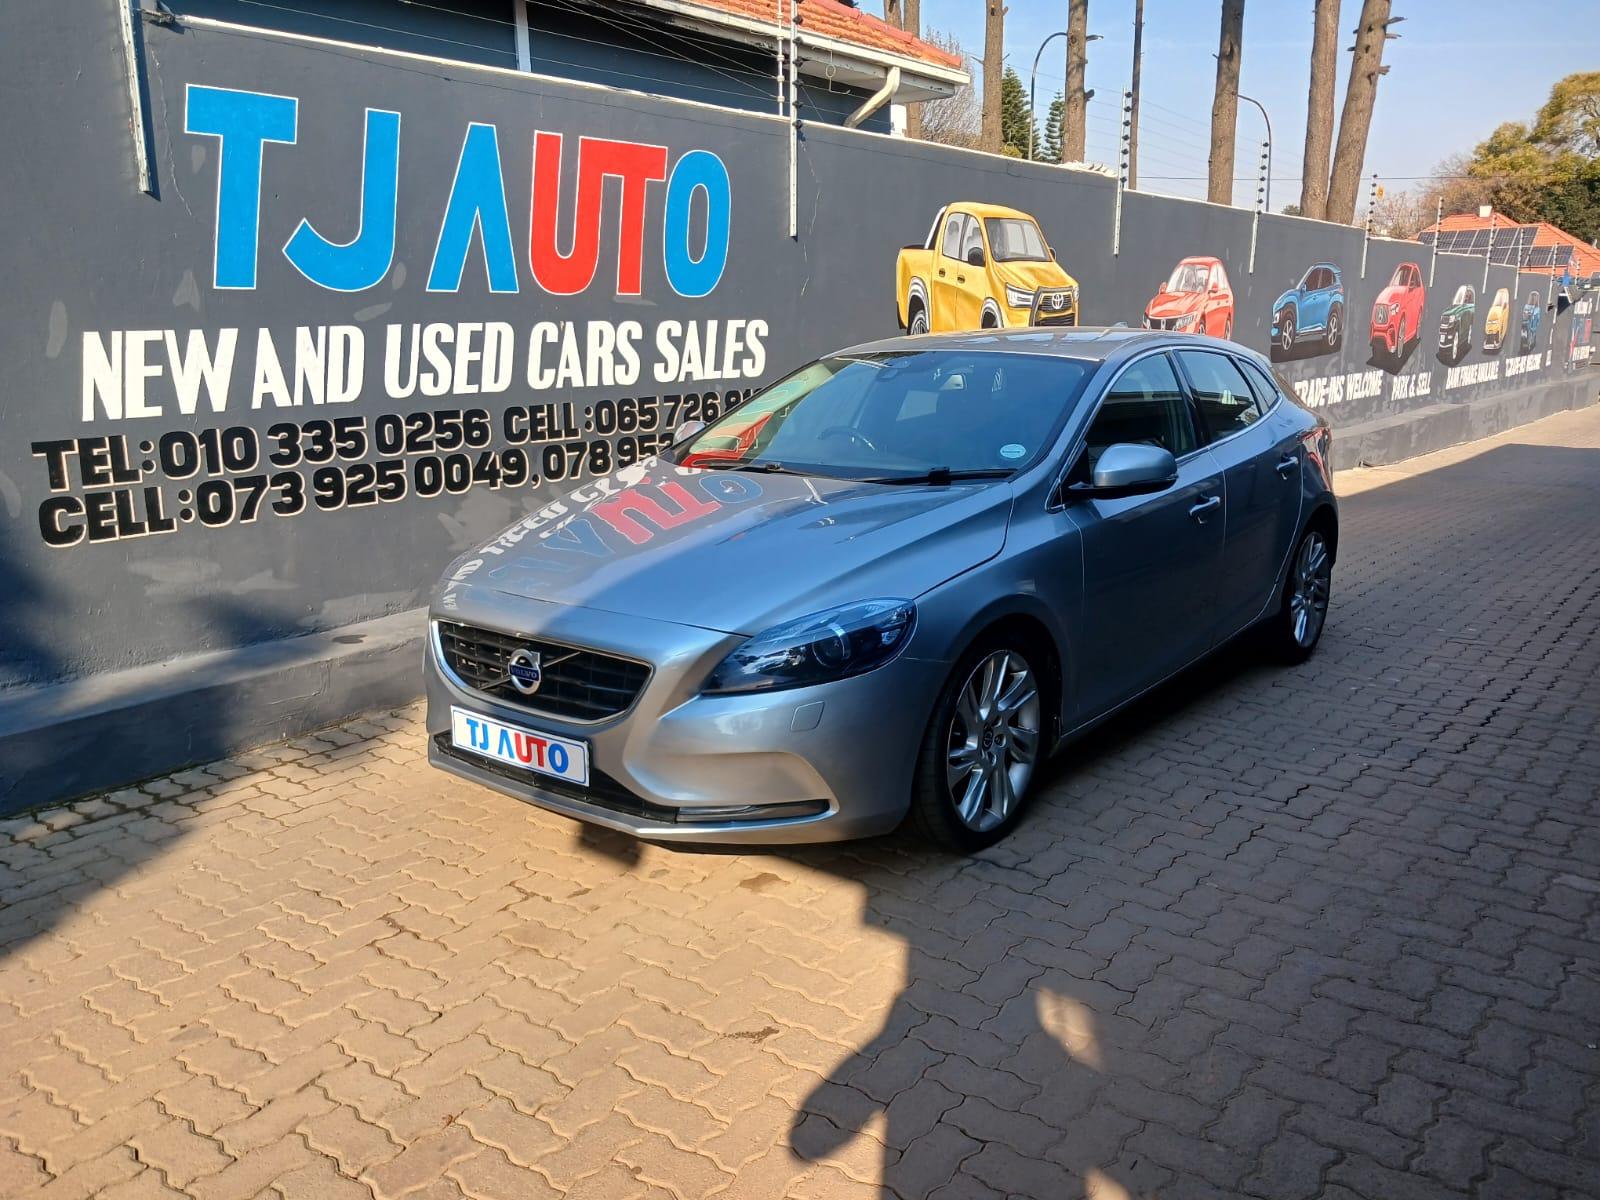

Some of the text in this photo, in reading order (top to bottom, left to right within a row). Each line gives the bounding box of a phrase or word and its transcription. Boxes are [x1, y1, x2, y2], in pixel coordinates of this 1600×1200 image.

[185, 83, 731, 297] TJ AUTO
[81, 319, 769, 422] NEW AND USED CARS SALES
[1346, 369, 1384, 400] WELCOME
[1416, 371, 1432, 396] SELL
[267, 416, 368, 469] 335
[375, 408, 491, 457] 0256
[663, 391, 721, 430] 726
[312, 459, 408, 512] 925
[466, 718, 569, 774] TJ AUTO
